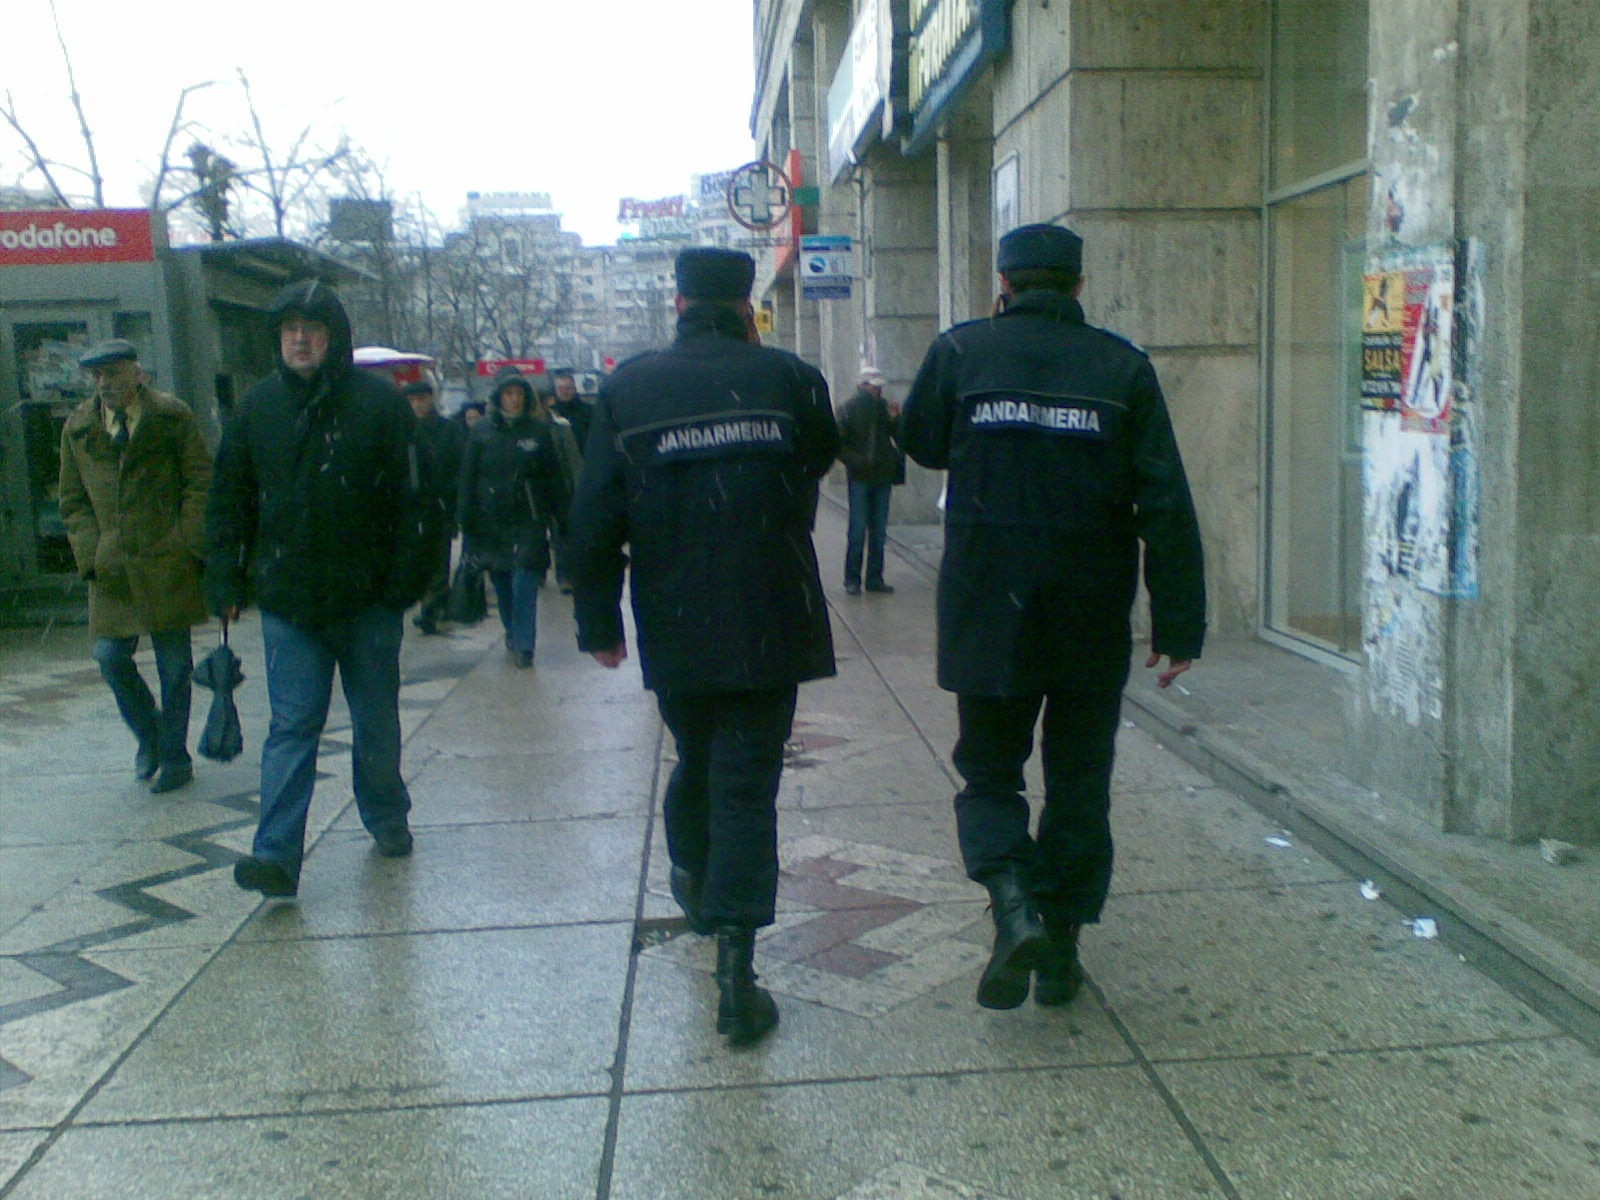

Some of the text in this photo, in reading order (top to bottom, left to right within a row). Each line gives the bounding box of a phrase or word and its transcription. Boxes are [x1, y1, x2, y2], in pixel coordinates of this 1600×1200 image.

[0, 221, 117, 249] odafone
[971, 400, 1100, 432] JANDARMERIA
[656, 420, 782, 455] JANDARMERIA
